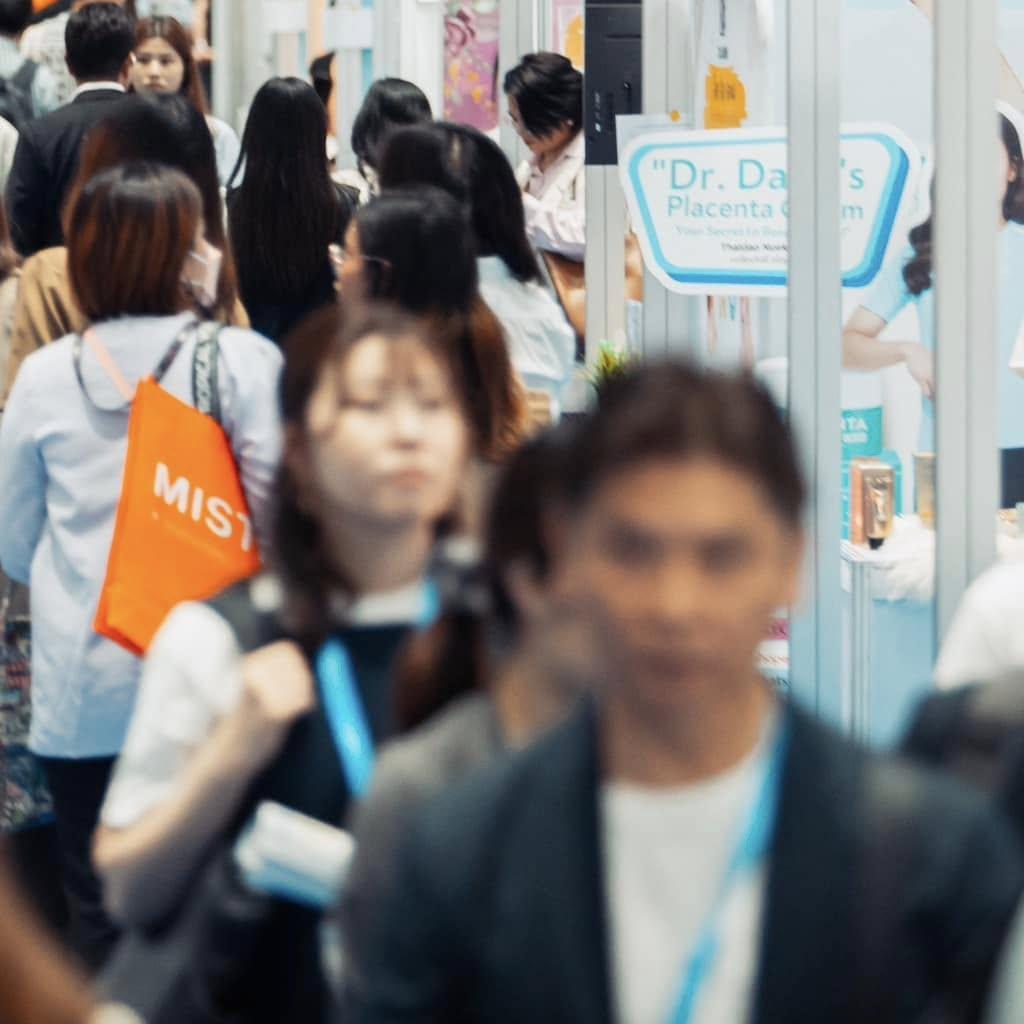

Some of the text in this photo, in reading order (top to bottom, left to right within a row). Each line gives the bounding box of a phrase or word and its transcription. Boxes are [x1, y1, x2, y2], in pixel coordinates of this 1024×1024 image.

[652, 158, 725, 190] "Dr.
[667, 194, 774, 219] Placenta
[153, 462, 252, 552] MIST
